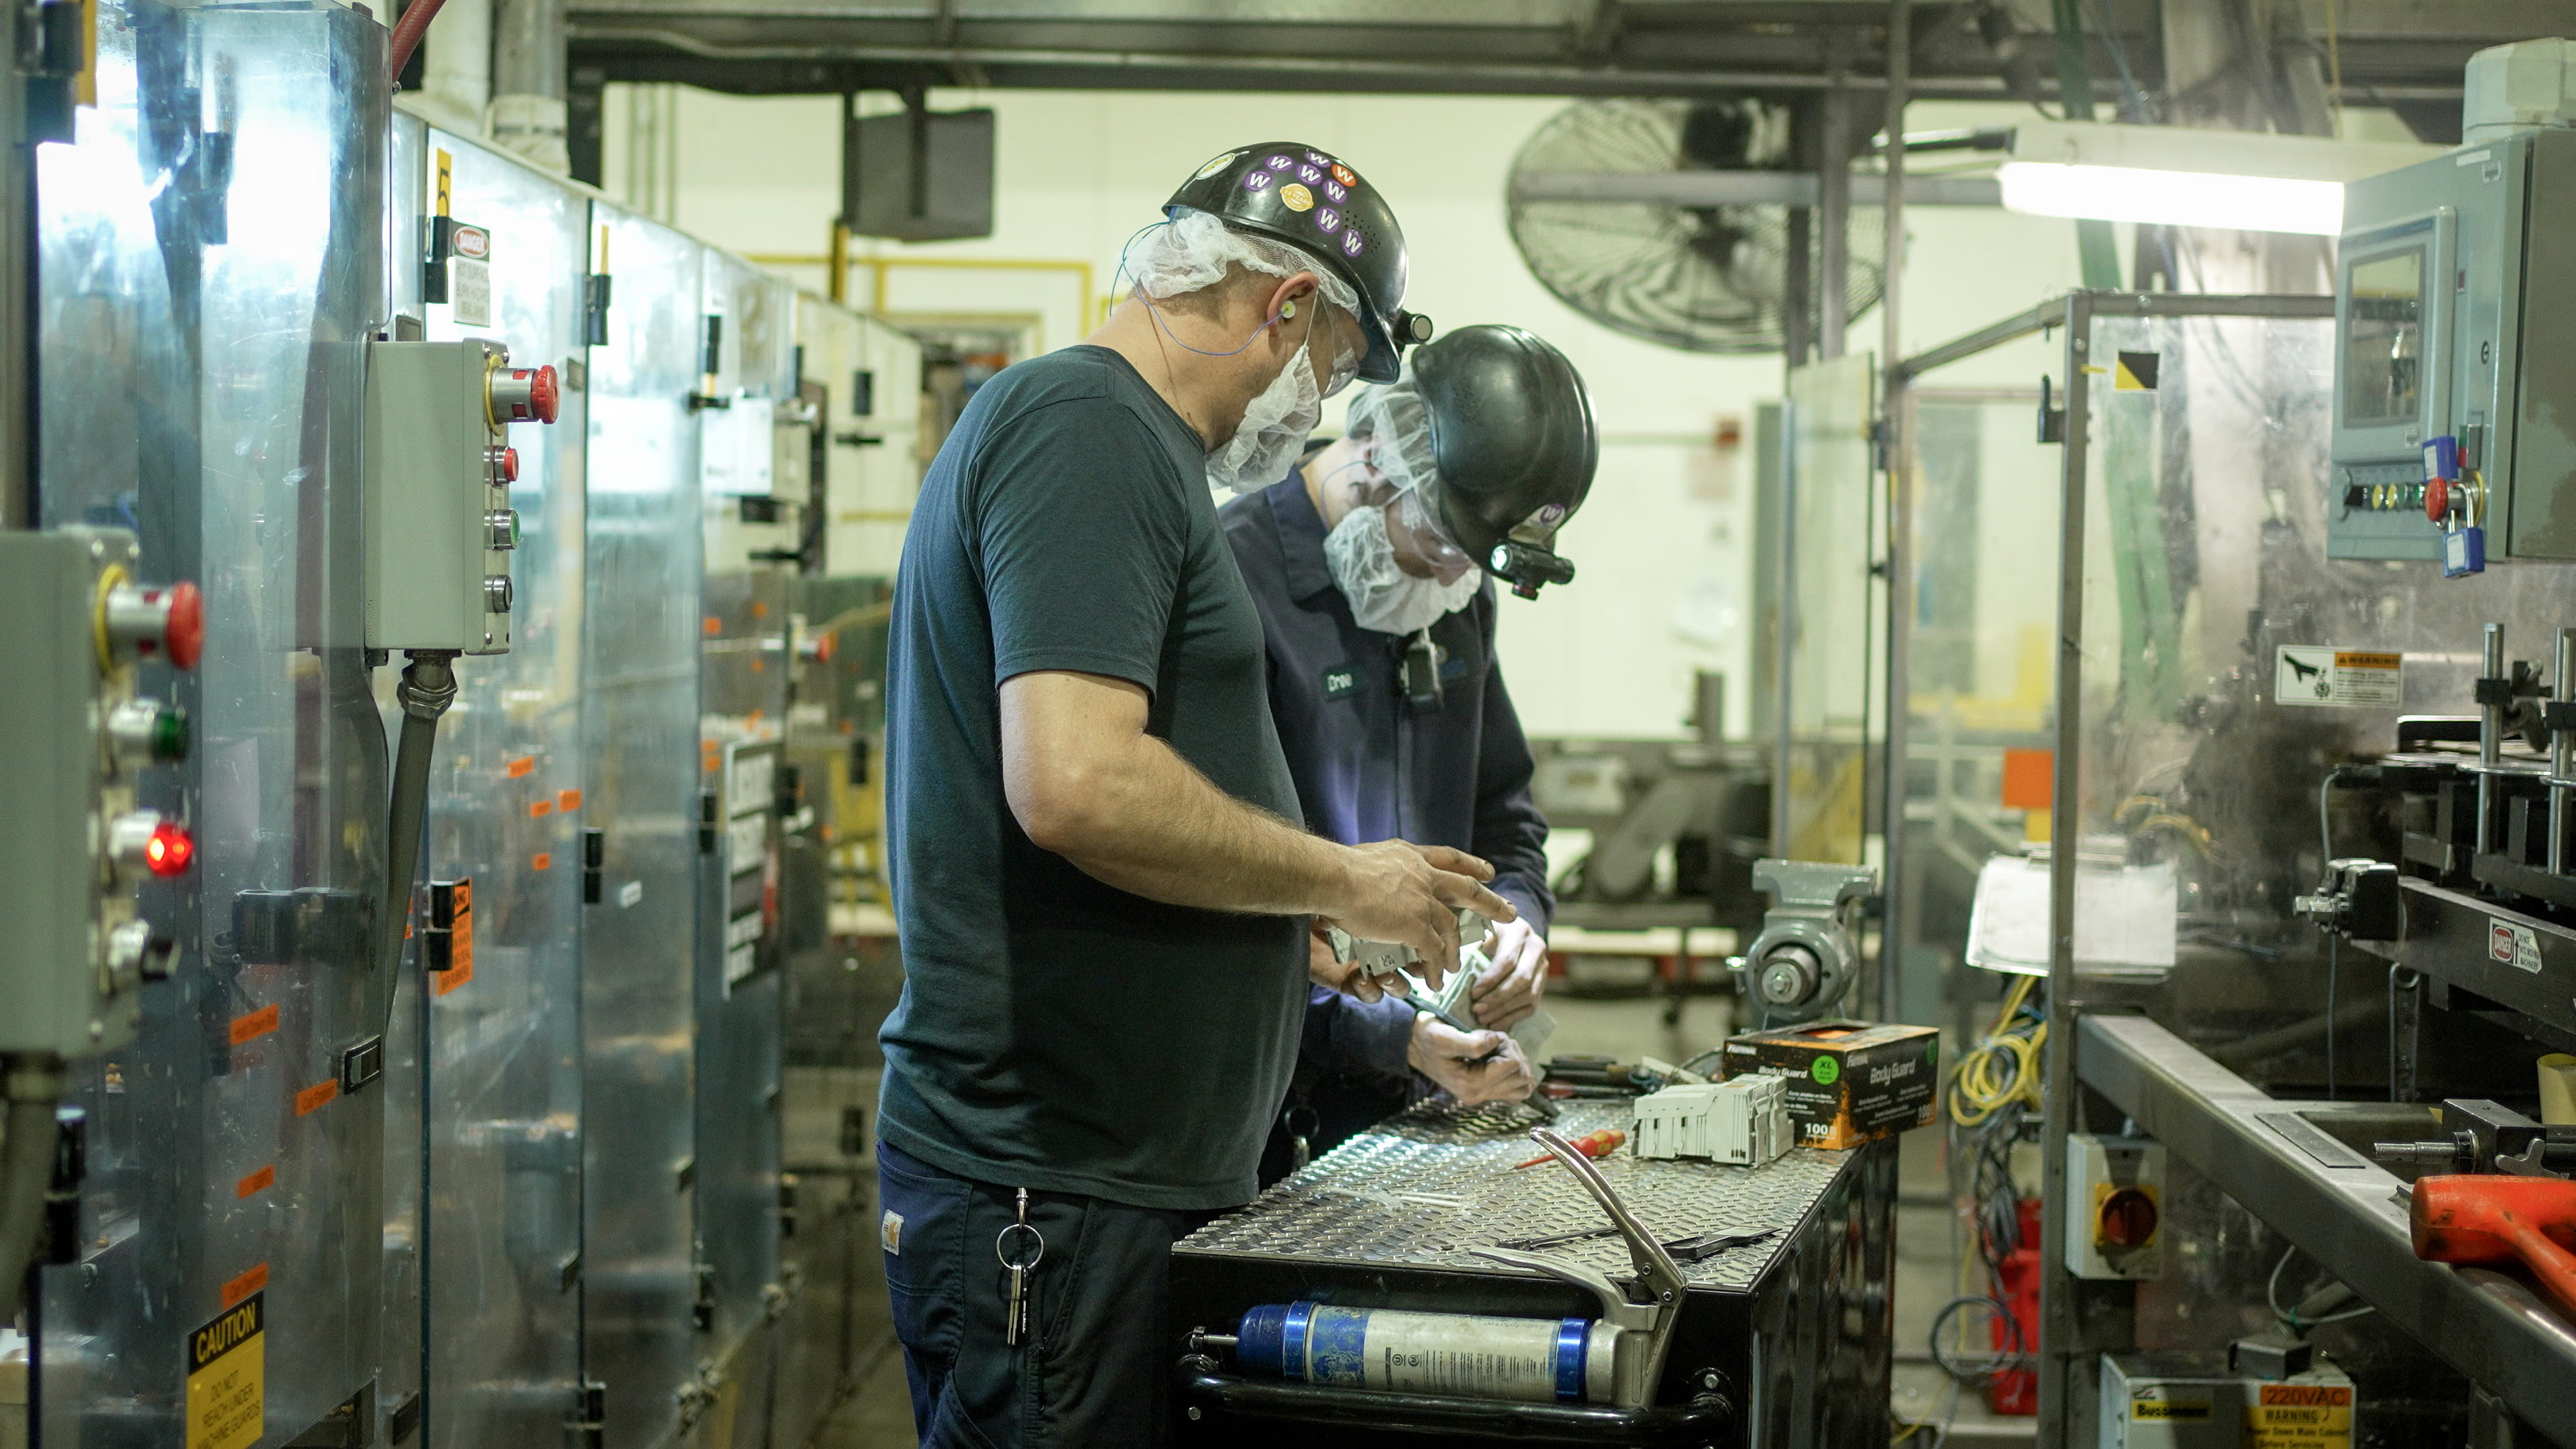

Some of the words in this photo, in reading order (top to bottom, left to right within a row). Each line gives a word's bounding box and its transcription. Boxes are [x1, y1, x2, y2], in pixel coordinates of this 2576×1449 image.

[1271, 156, 1291, 169] W
[1250, 173, 1271, 188] W
[1300, 165, 1321, 182] W
[1336, 166, 1354, 182] W
[1328, 182, 1346, 200] W
[1320, 209, 1339, 230] W
[459, 231, 485, 254] DANGER
[1345, 233, 1362, 254] W
[2495, 933, 2512, 954] DANGER
[1758, 1065, 1781, 1076] Body
[1781, 1067, 1809, 1079] Guard
[1820, 1061, 1833, 1069] XL
[1870, 1065, 1892, 1087] Body
[1891, 1057, 1917, 1079] Guard
[1805, 1123, 1829, 1135] 100
[196, 1301, 256, 1364] CAUTION
[2267, 1388, 2346, 1405] 220VAC
[2265, 1409, 2319, 1423] WARNING
